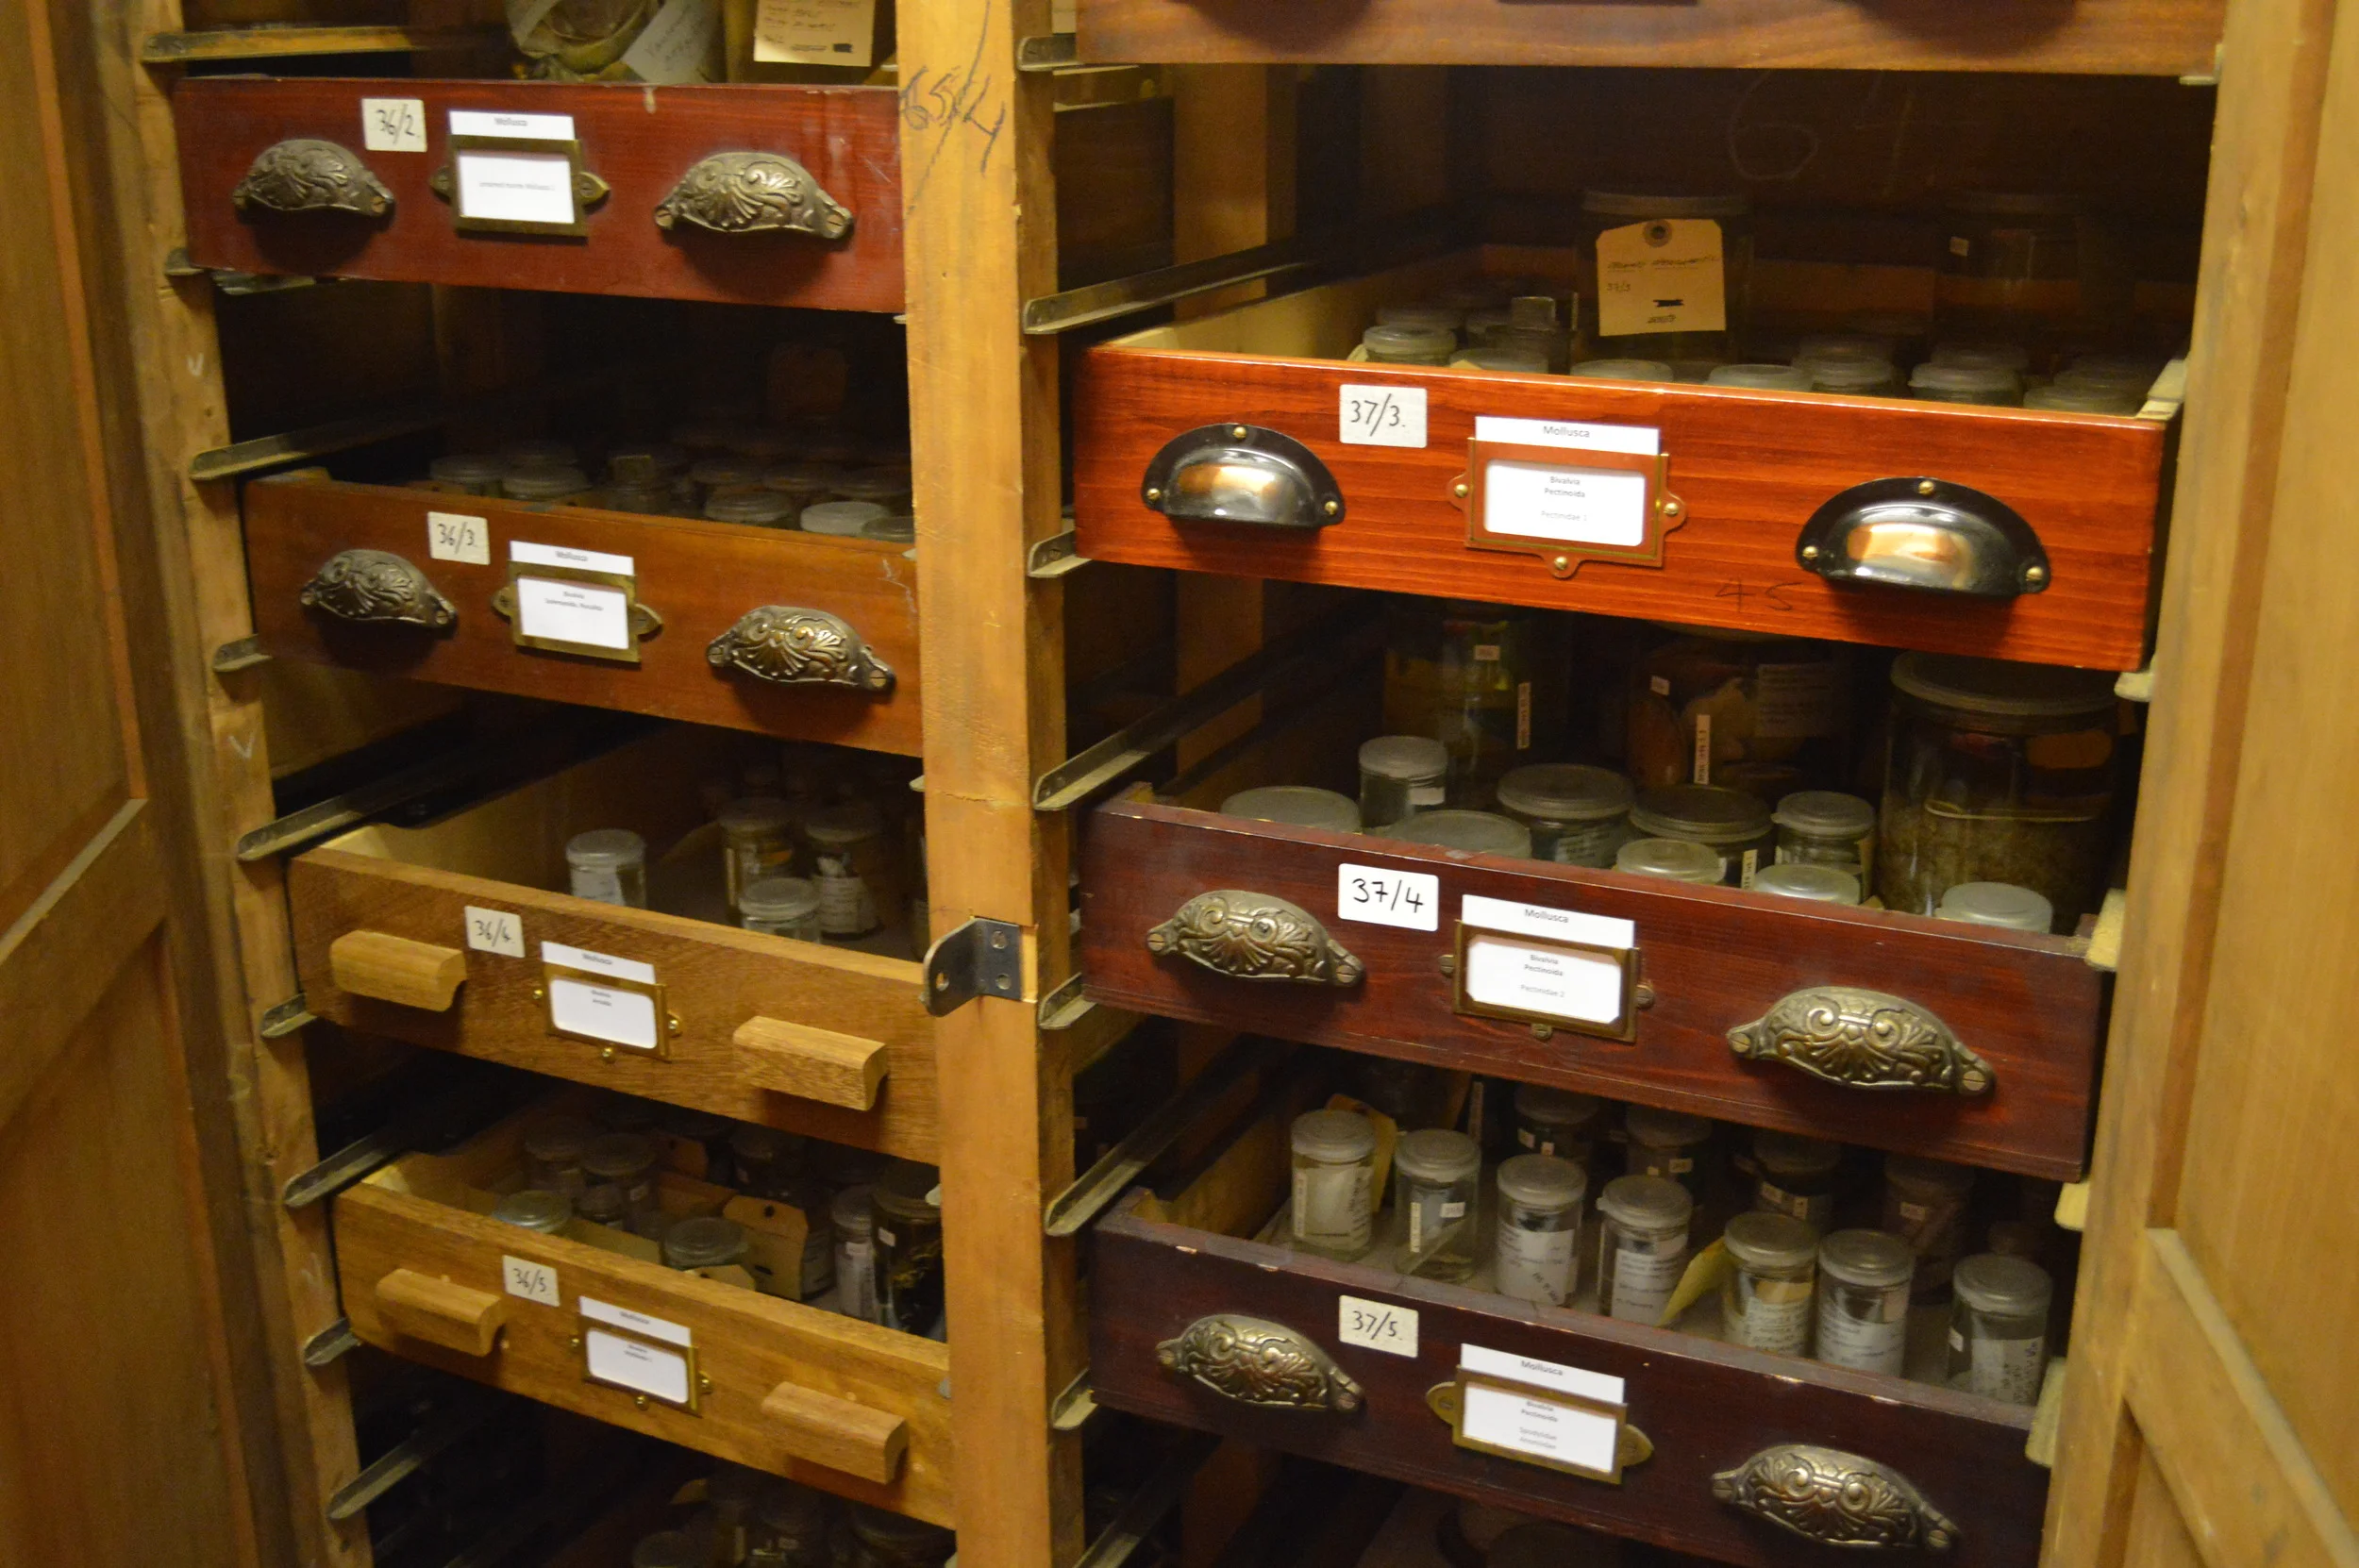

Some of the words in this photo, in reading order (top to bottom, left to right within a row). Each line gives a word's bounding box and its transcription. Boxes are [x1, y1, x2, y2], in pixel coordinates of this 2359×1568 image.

[1543, 425, 1590, 439] Mollusca
[1549, 475, 1581, 486] Bivalvia
[1544, 487, 1585, 498] Pectinoida
[1352, 877, 1424, 913] 37/4
[1524, 908, 1570, 925] Mollusca
[1530, 953, 1560, 965] Bivalvia
[1523, 963, 1564, 977] Pectinoida
[1520, 1359, 1564, 1377] Mollusca
